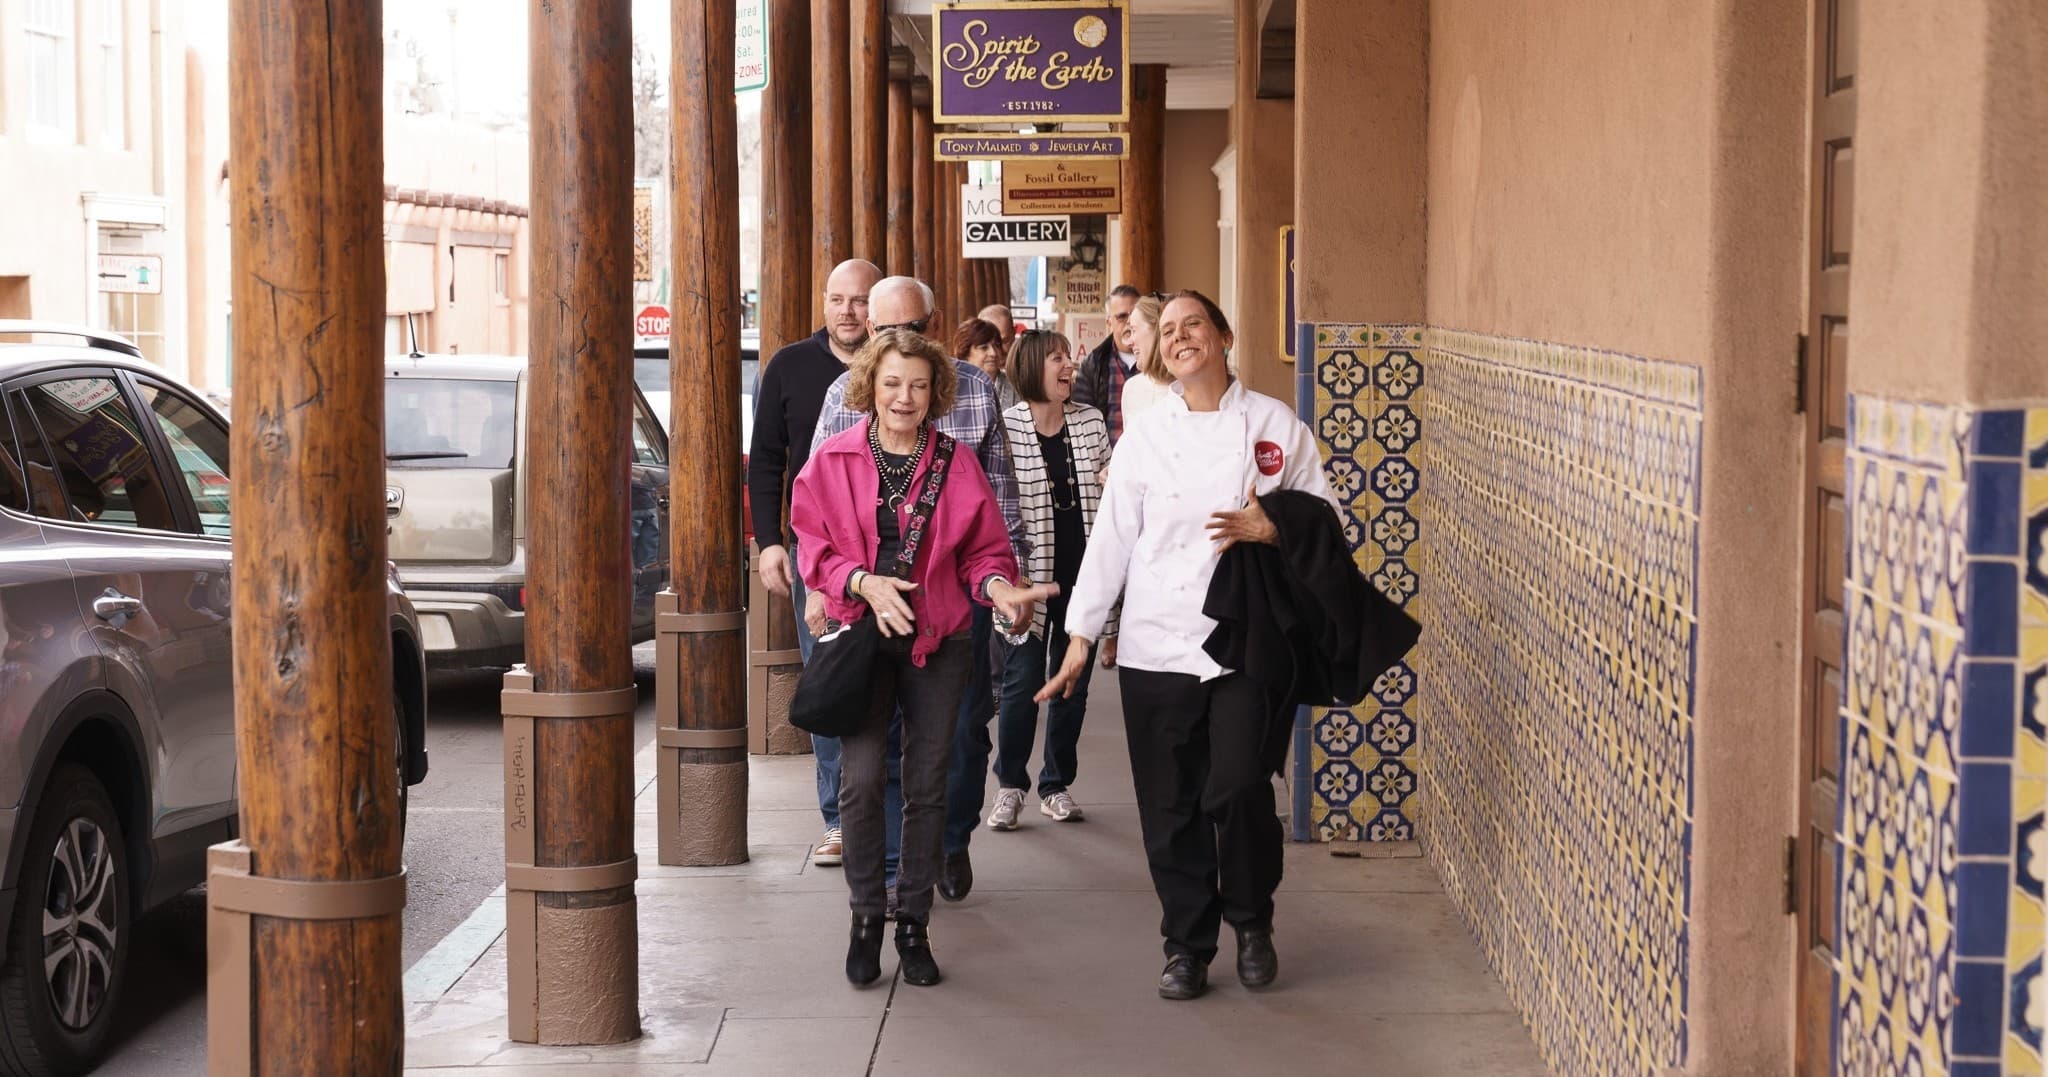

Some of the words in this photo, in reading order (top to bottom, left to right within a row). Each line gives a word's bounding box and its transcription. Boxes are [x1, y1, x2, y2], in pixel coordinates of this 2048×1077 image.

[943, 19, 1041, 72] Spirit
[963, 55, 1007, 88] of
[1005, 57, 1037, 82] the
[1041, 51, 1114, 90] Earth
[1030, 101, 1054, 111] 1982
[1056, 163, 1065, 172] &
[1025, 173, 1054, 184] Fossil
[1058, 172, 1098, 184] Gallery
[1020, 201, 1057, 210] Collectors
[1058, 201, 1071, 209] and
[966, 222, 1067, 241] GALLERY
[1067, 281, 1101, 293] RUBBER
[1067, 293, 1101, 305] STAMPS
[638, 316, 670, 334] STOP
